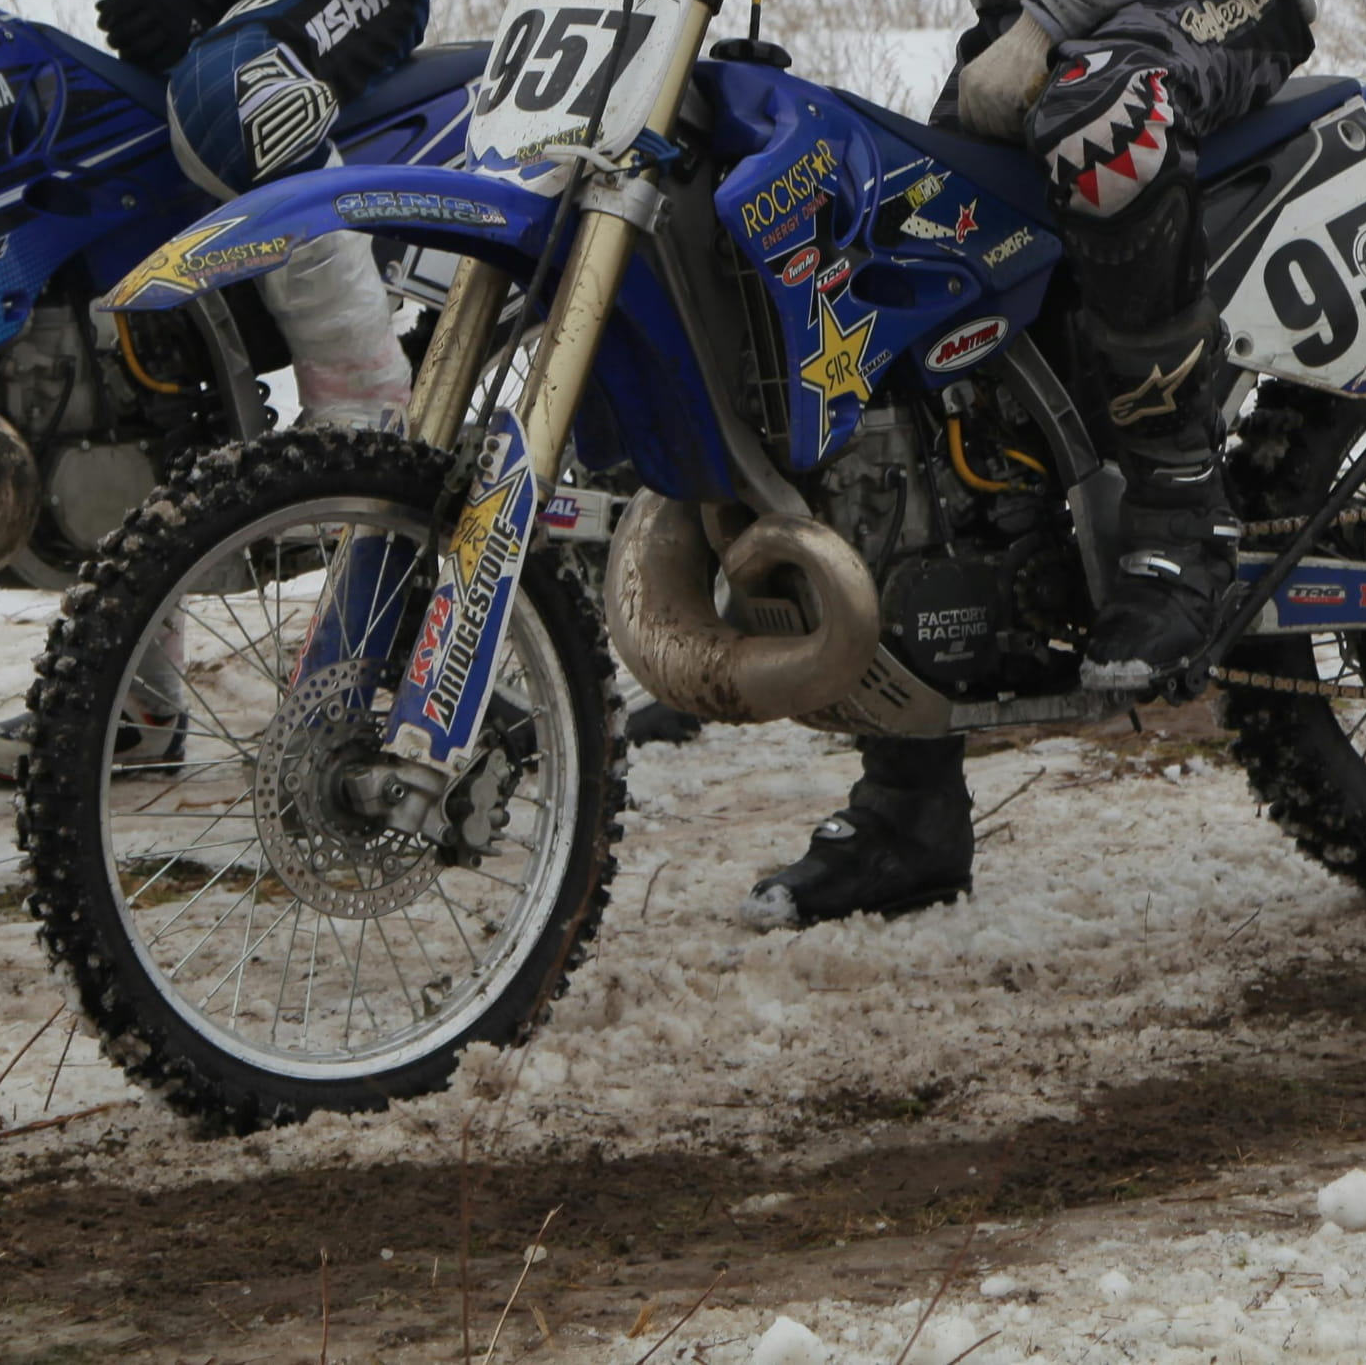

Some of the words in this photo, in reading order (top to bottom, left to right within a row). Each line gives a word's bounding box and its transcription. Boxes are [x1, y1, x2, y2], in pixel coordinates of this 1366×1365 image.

[475, 8, 657, 118] 957
[351, 207, 483, 225] GRAPHICS
[761, 214, 800, 250] ENERGY
[802, 192, 828, 221] DRINK
[408, 595, 452, 687] KYB
[424, 515, 517, 736] BRIDGESTONE
[917, 607, 987, 627] FACTORY
[917, 622, 987, 641] RACING
